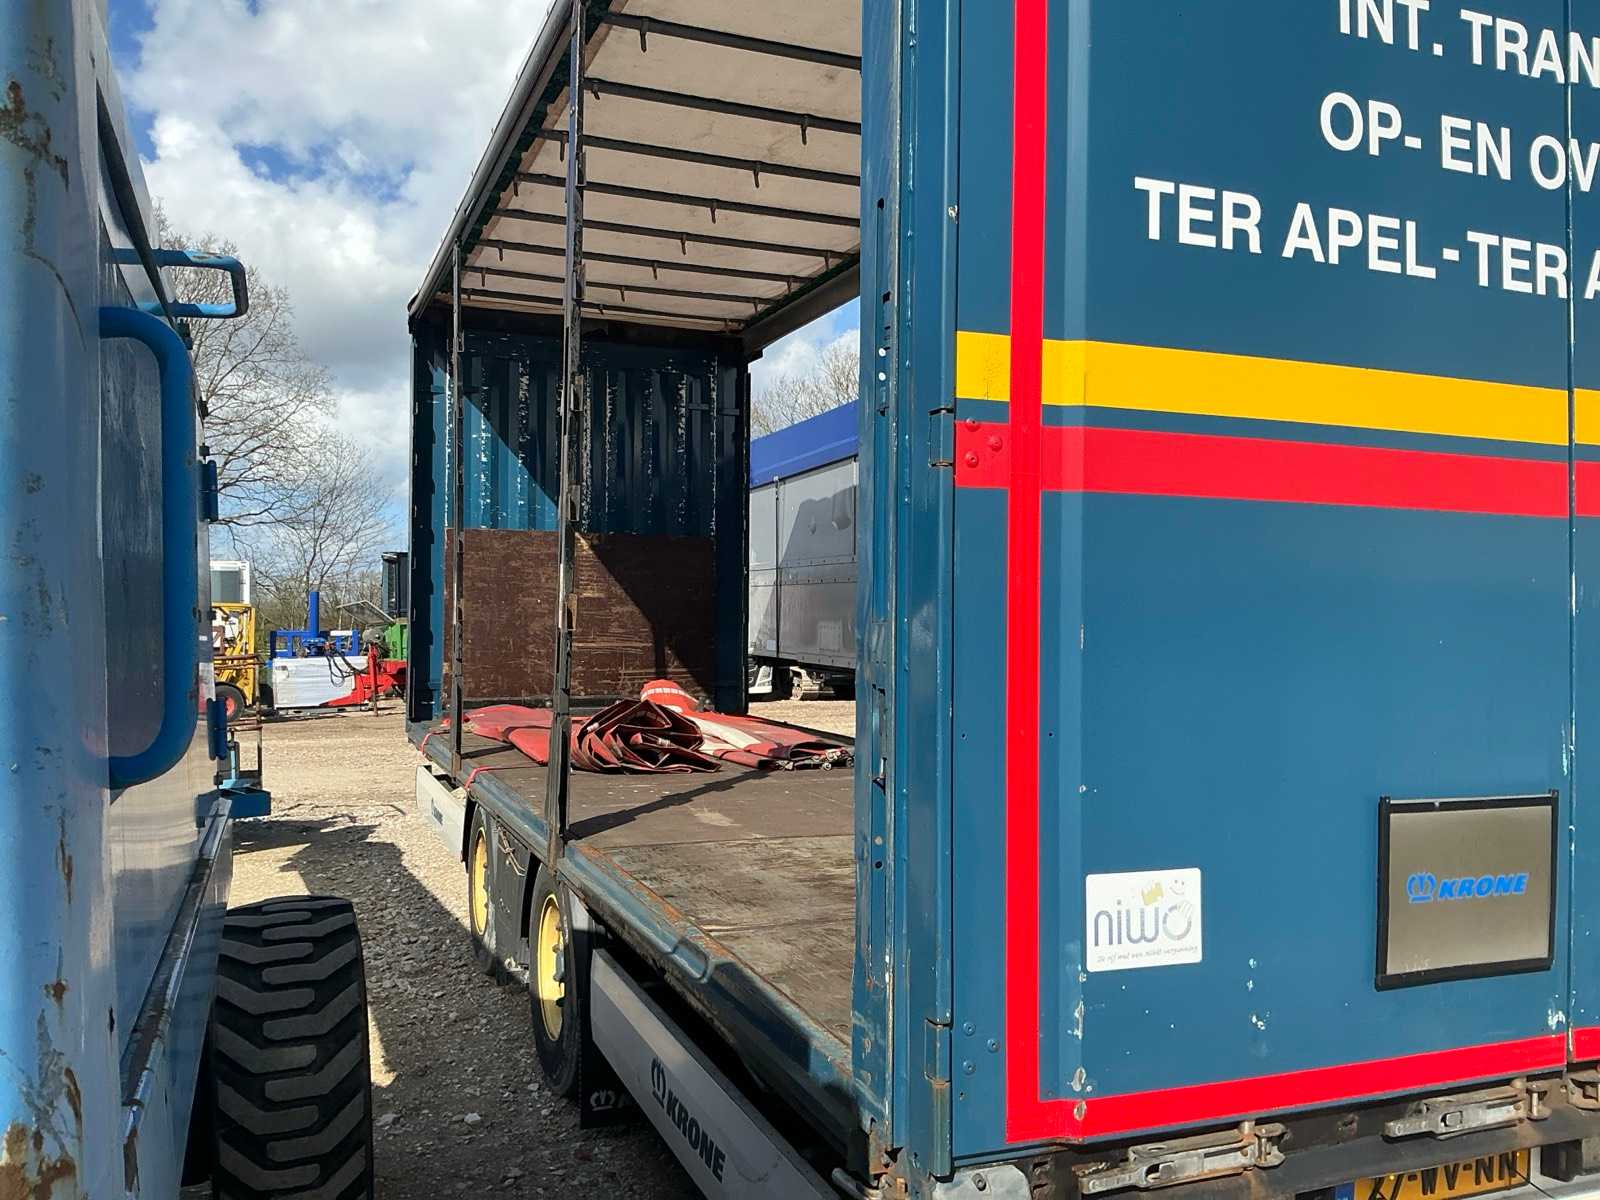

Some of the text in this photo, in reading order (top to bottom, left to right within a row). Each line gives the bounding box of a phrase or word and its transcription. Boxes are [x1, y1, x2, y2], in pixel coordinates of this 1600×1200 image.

[1338, 0, 1600, 89] INT. TRAN
[1320, 92, 1600, 192] OP- EN OV
[1134, 177, 1262, 254] TER
[1094, 899, 1193, 947] niwo
[1439, 873, 1529, 900] KRONE
[666, 1088, 726, 1184] KRONE
